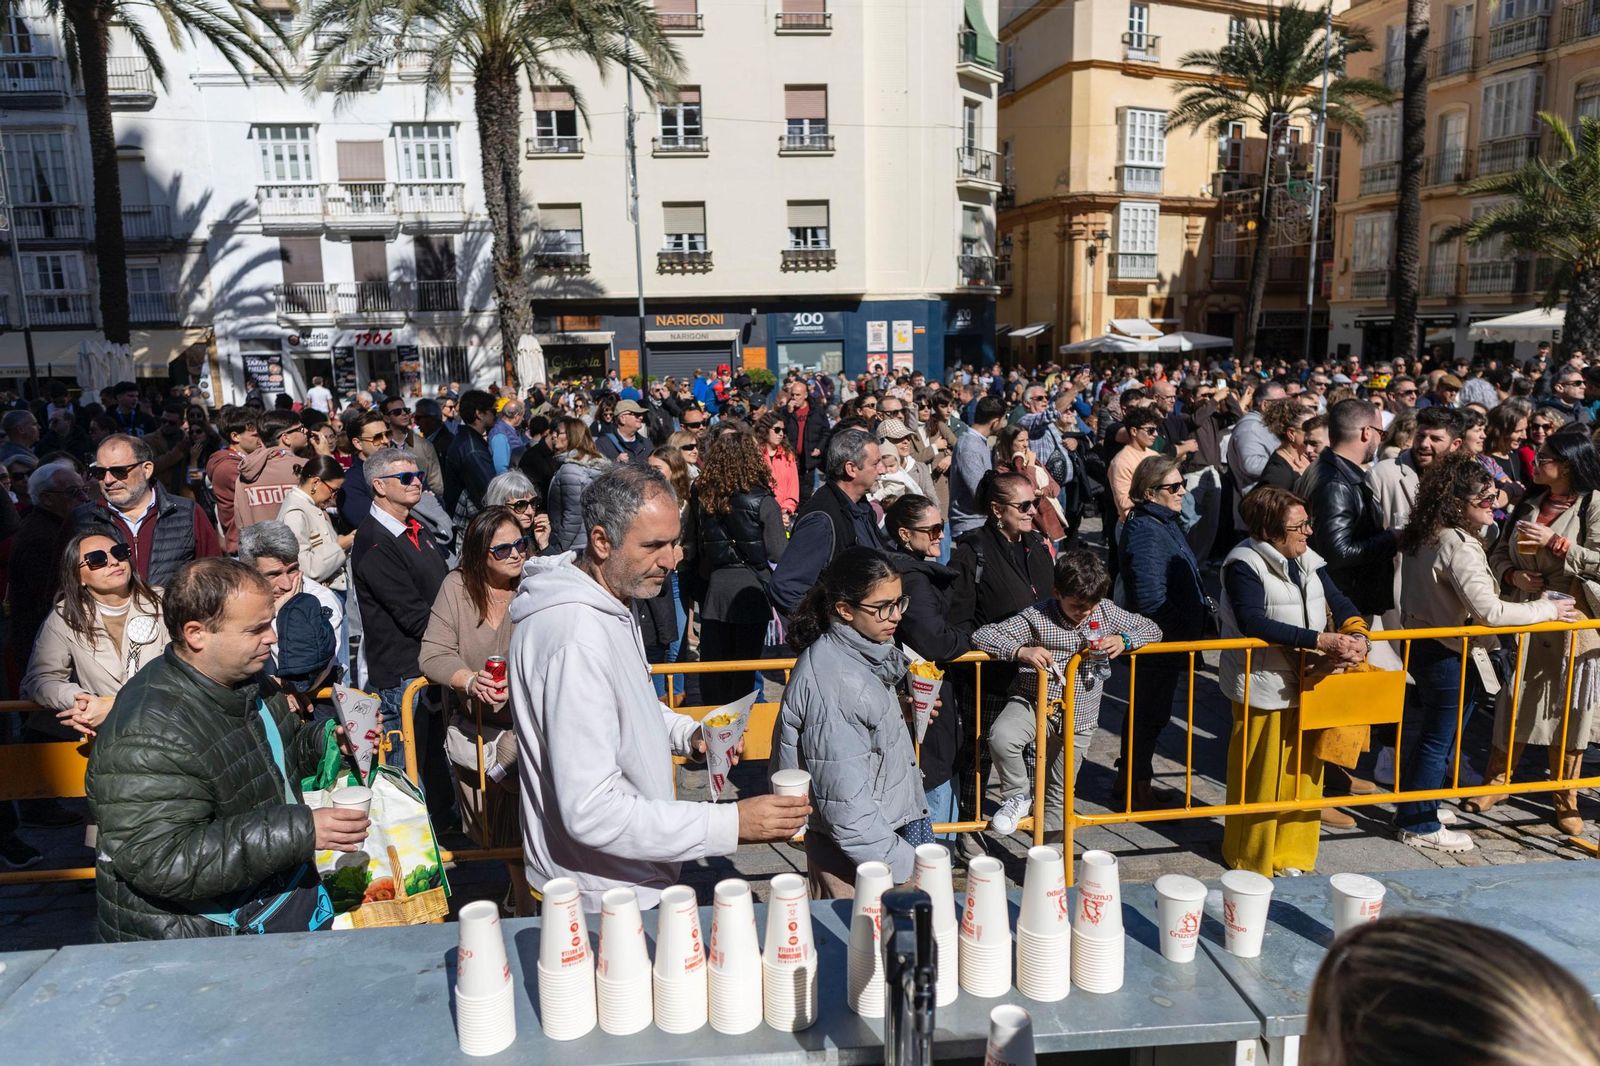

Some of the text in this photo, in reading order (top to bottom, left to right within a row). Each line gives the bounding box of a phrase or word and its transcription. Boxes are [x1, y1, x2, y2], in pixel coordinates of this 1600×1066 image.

[656, 314, 724, 326] NARIGONI
[793, 312, 824, 326] 100
[355, 332, 393, 346] 1906
